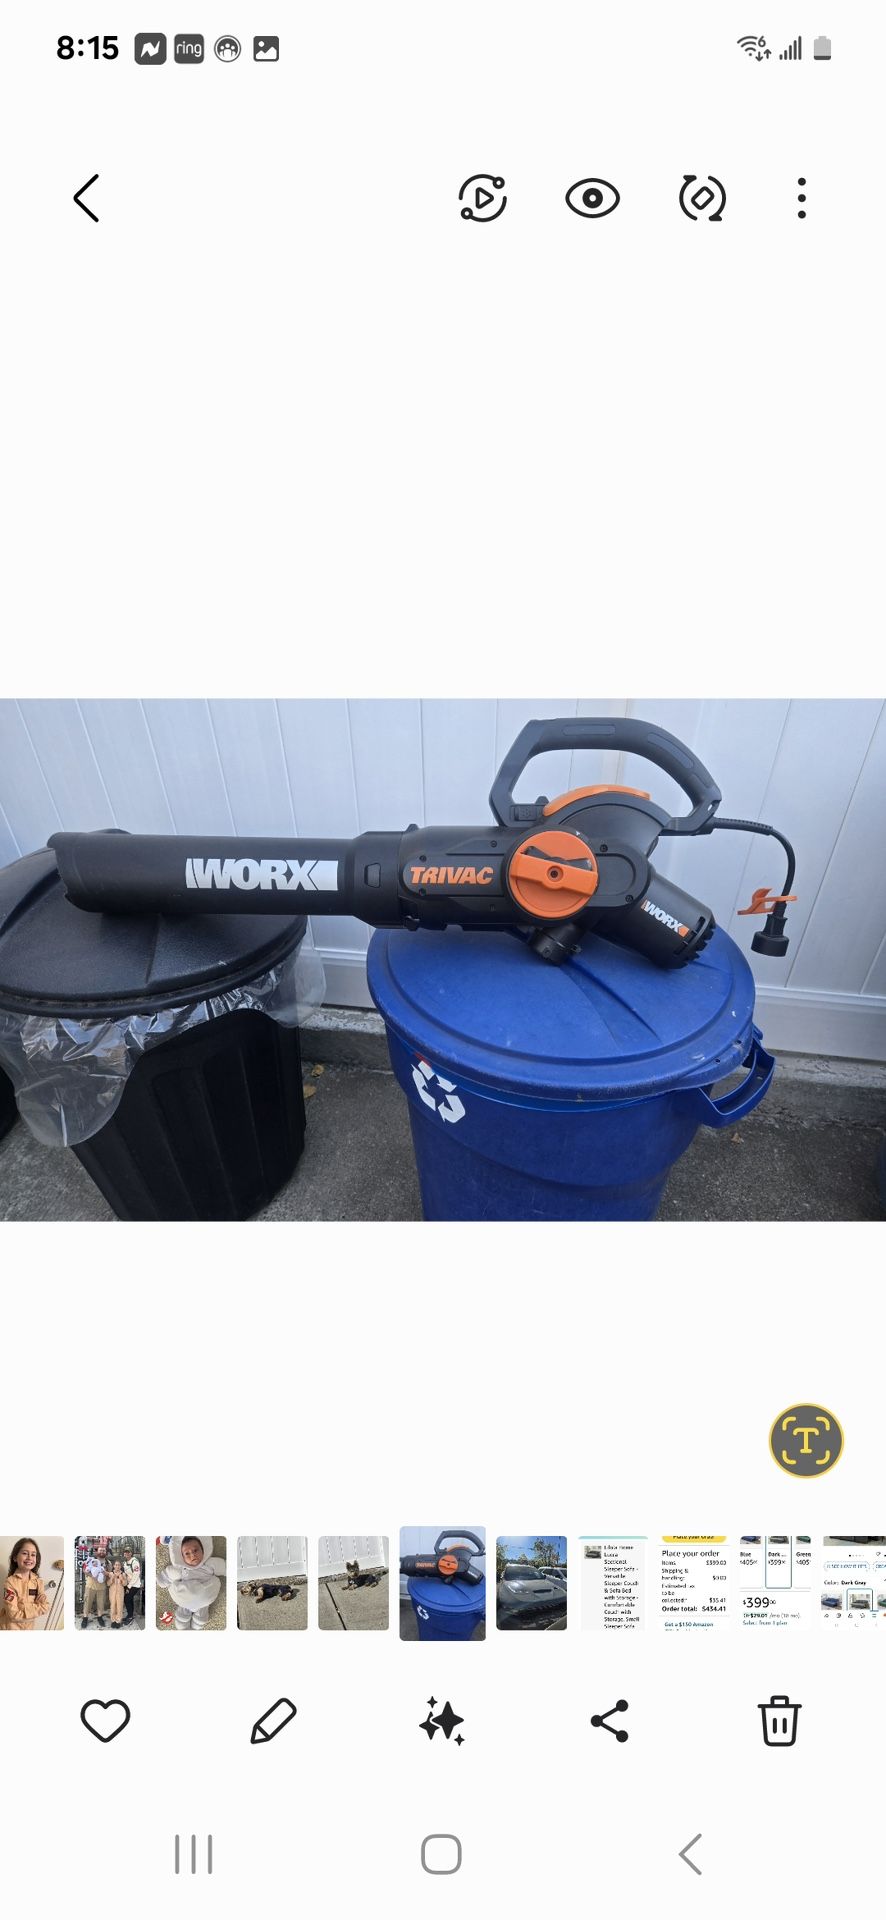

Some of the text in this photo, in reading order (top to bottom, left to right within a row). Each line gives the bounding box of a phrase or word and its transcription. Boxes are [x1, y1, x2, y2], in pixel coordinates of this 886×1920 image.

[57, 35, 119, 60] 8:15
[176, 40, 202, 58] ring
[757, 35, 767, 48] 6
[190, 857, 326, 891] WORX
[409, 865, 494, 886] TRIVAC
[642, 900, 686, 934] WORX
